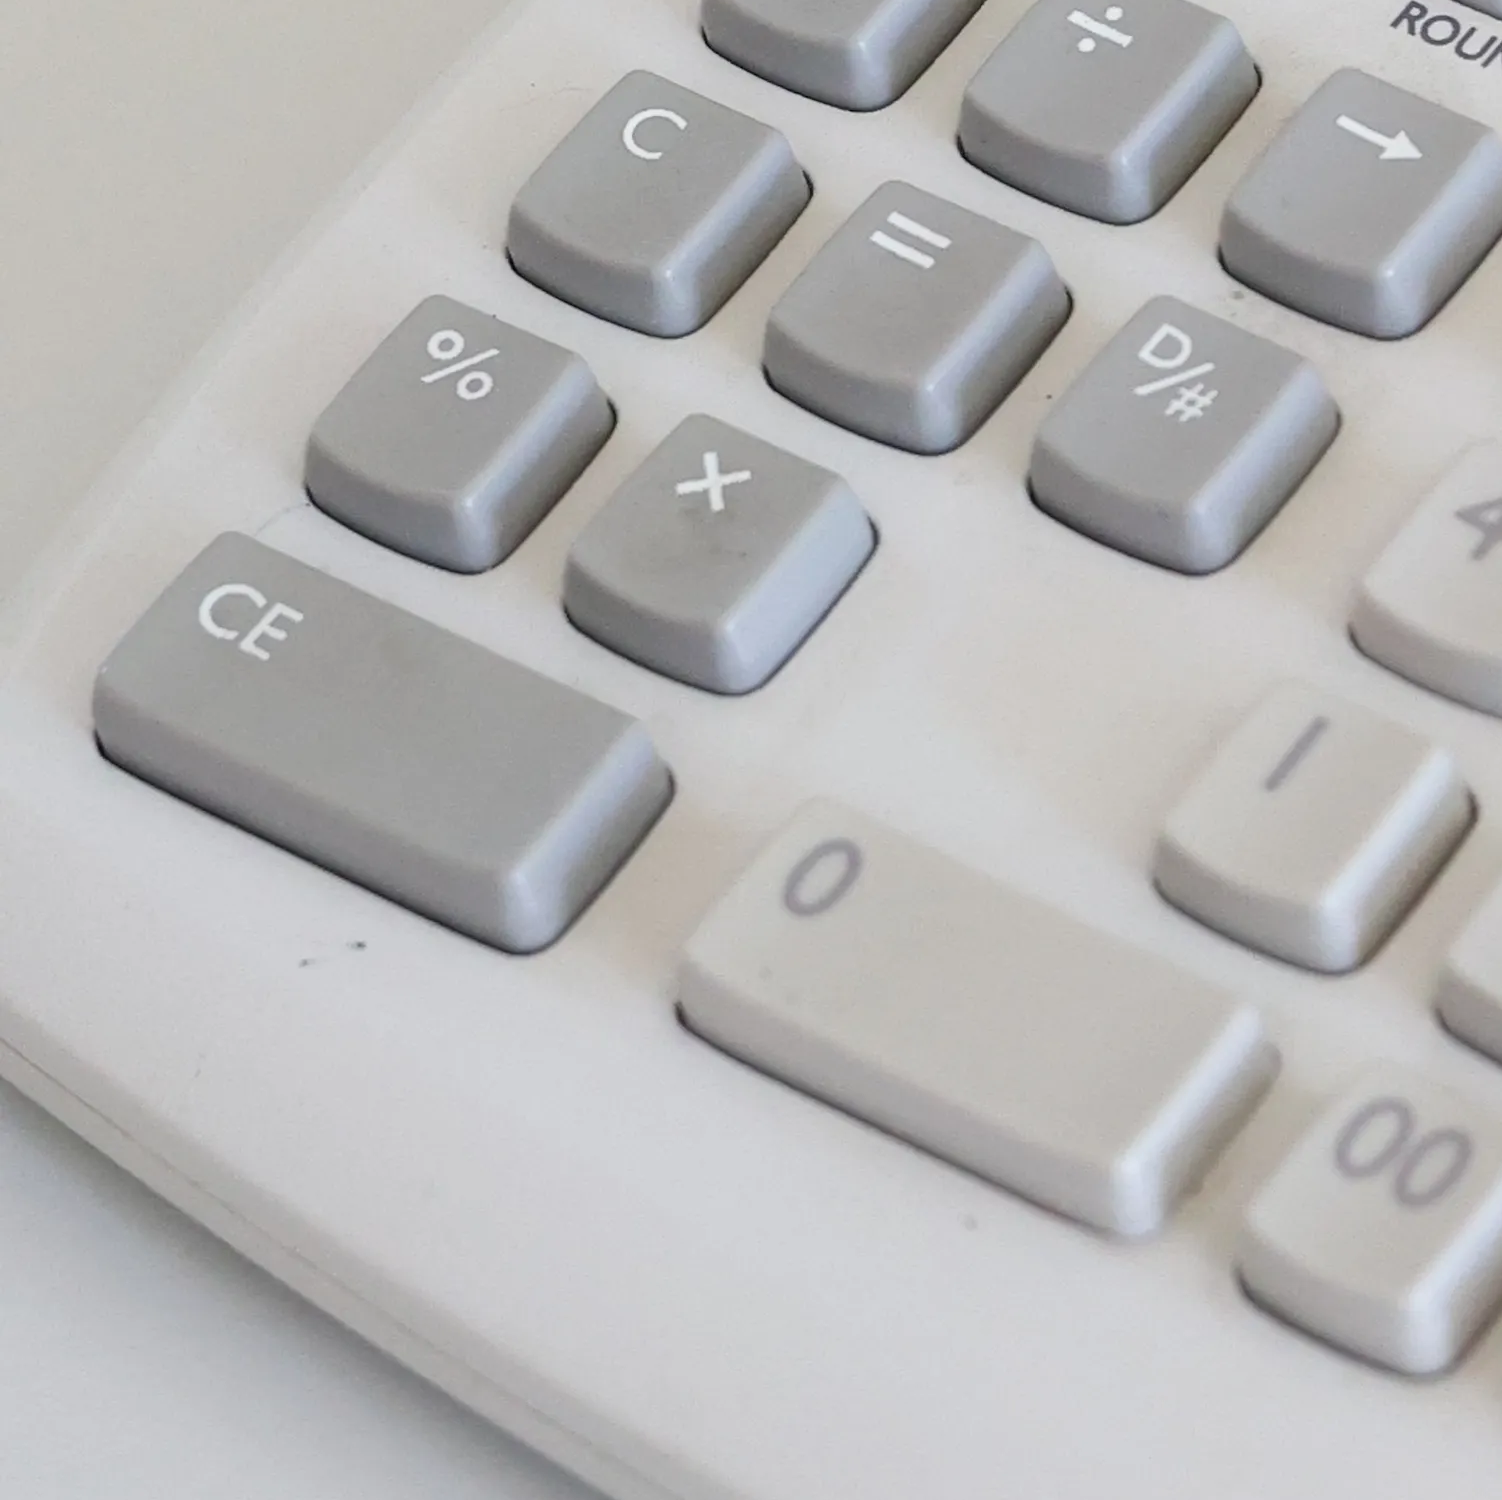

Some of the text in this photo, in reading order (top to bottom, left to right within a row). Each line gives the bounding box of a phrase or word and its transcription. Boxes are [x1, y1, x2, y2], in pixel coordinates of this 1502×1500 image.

[623, 108, 687, 159] C
[421, 330, 500, 400] %
[198, 583, 304, 660] CE
[1264, 716, 1329, 792] 1
[783, 840, 863, 917] 0
[1335, 1100, 1474, 1210] 00
